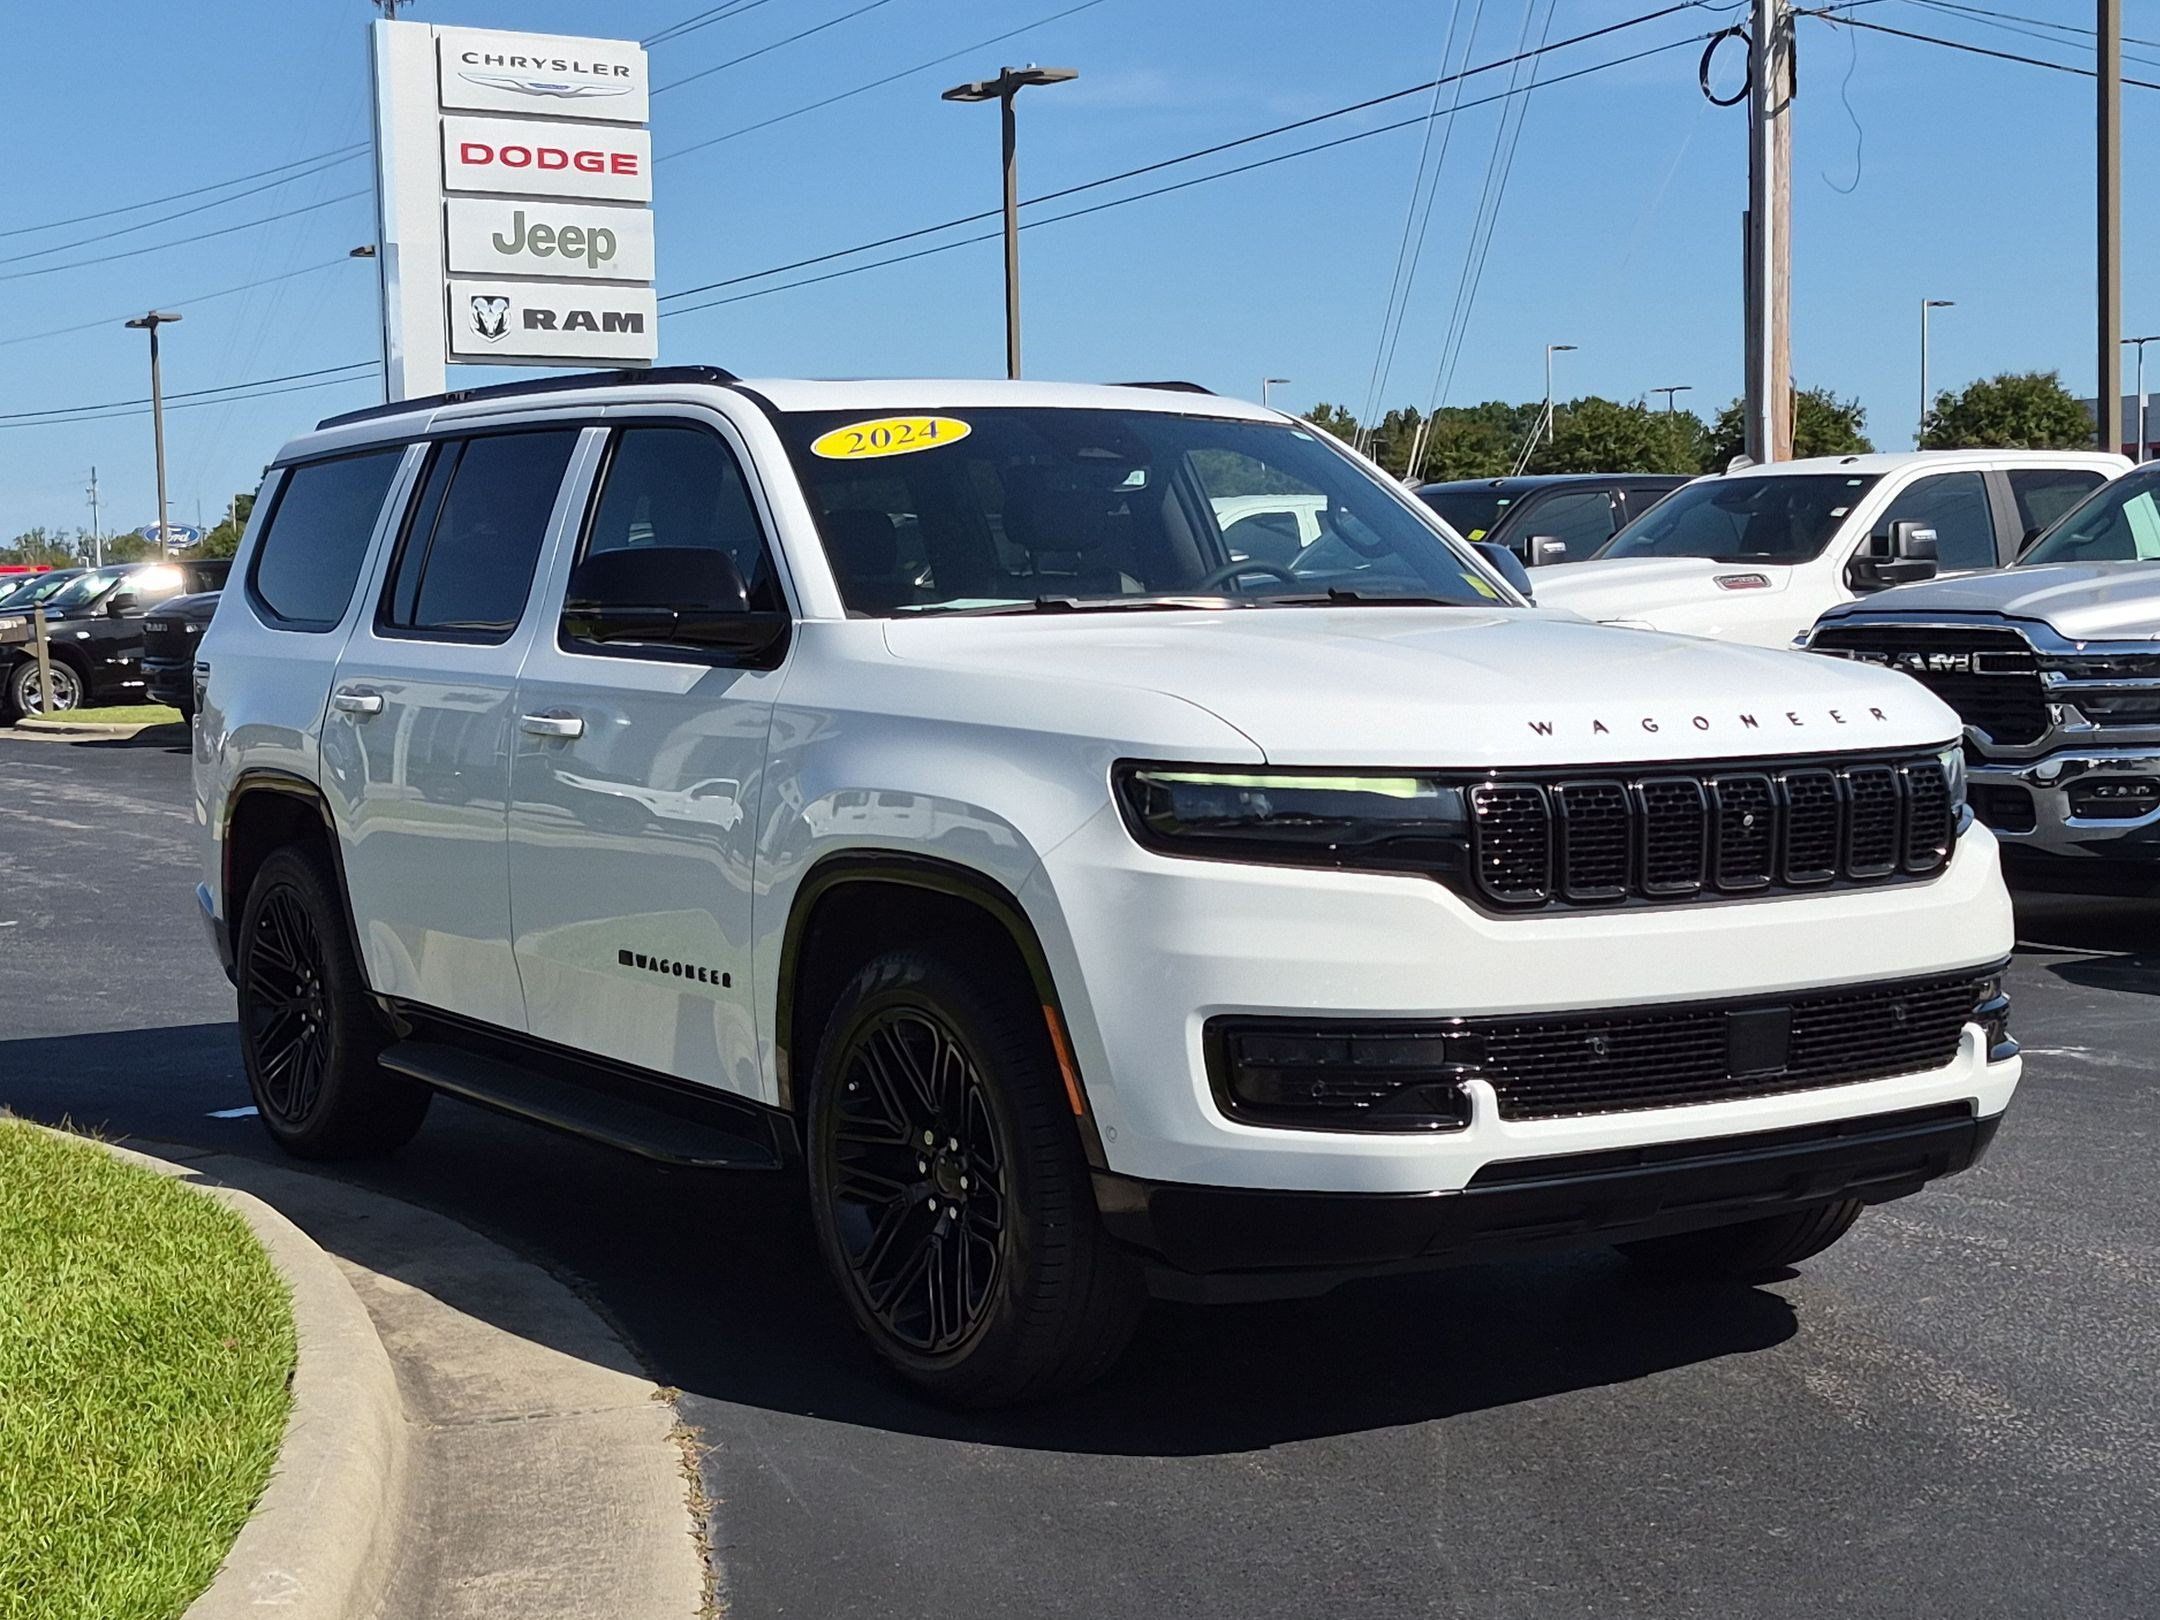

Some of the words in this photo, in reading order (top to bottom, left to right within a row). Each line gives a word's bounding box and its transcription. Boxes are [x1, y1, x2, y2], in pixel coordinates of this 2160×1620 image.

[461, 52, 631, 78] CHRYSLER
[460, 142, 639, 176] DODGE
[492, 210, 617, 269] Jeep
[523, 308, 645, 334] RAM
[845, 420, 940, 454] 2024
[1527, 707, 1888, 737] WAGONEER
[636, 953, 732, 988] WAGONEER
